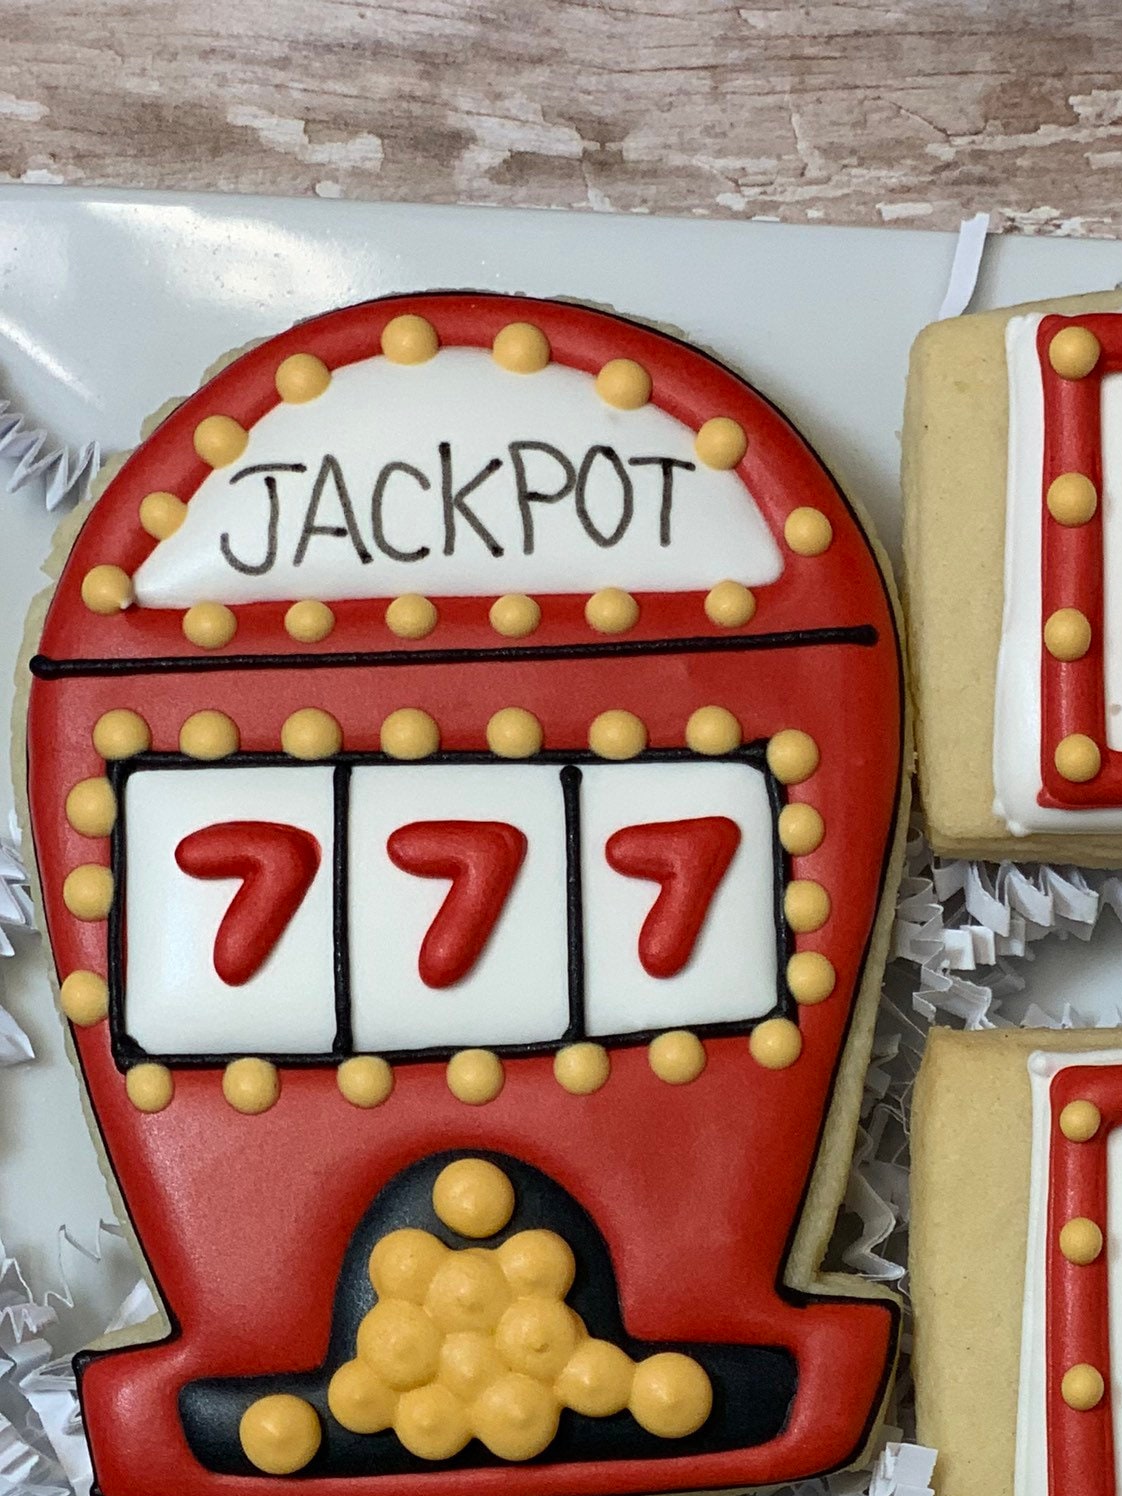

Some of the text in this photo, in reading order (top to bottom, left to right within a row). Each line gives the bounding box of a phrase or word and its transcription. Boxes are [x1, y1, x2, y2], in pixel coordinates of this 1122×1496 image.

[220, 440, 697, 576] JACKPOT
[174, 815, 742, 990] 7 7 7
